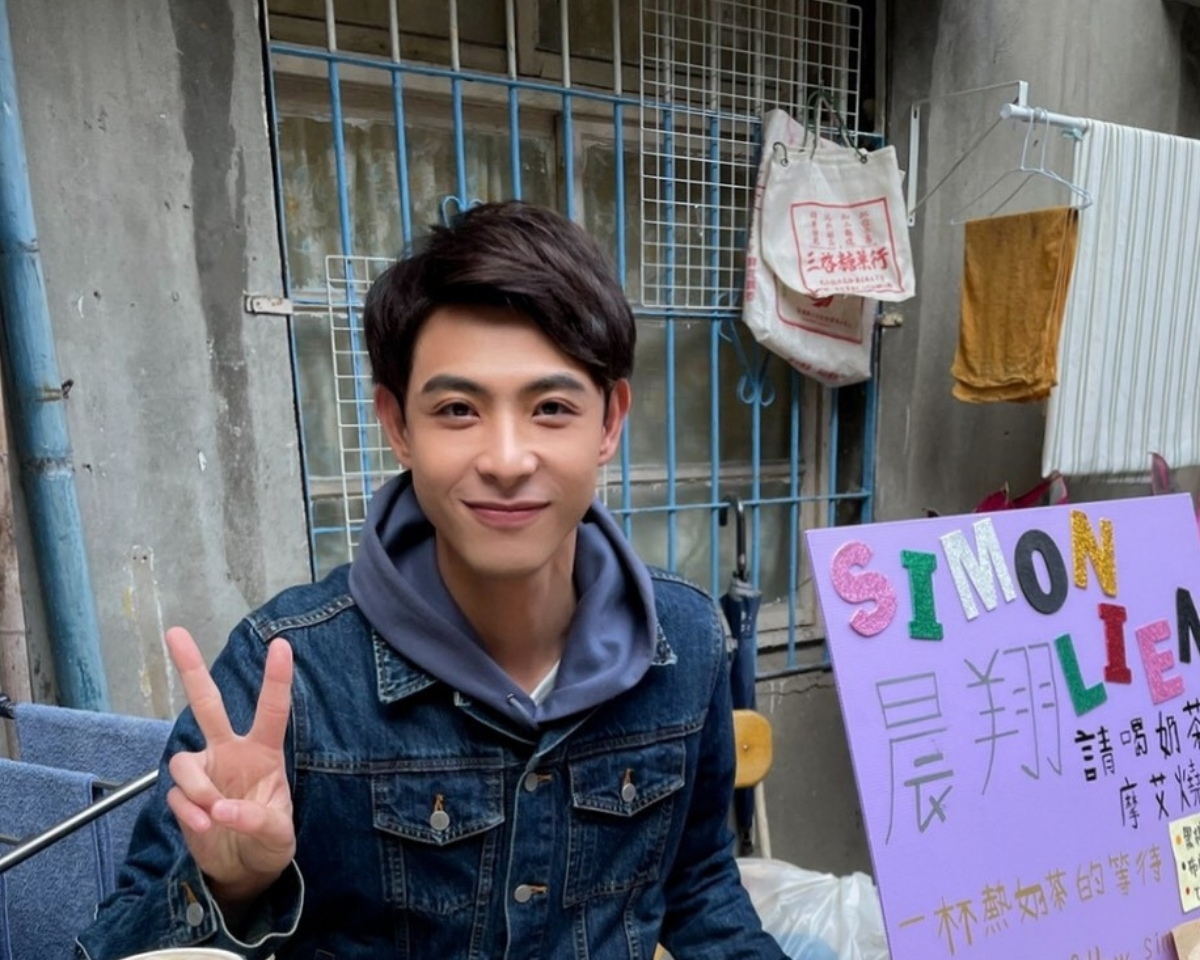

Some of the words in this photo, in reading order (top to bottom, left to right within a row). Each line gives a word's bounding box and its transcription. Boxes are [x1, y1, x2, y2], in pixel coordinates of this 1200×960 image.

[831, 509, 1118, 641] SIMON
[875, 643, 1063, 846] 晨翔
[898, 844, 1163, 956] 一杯熱奶茶的等待
